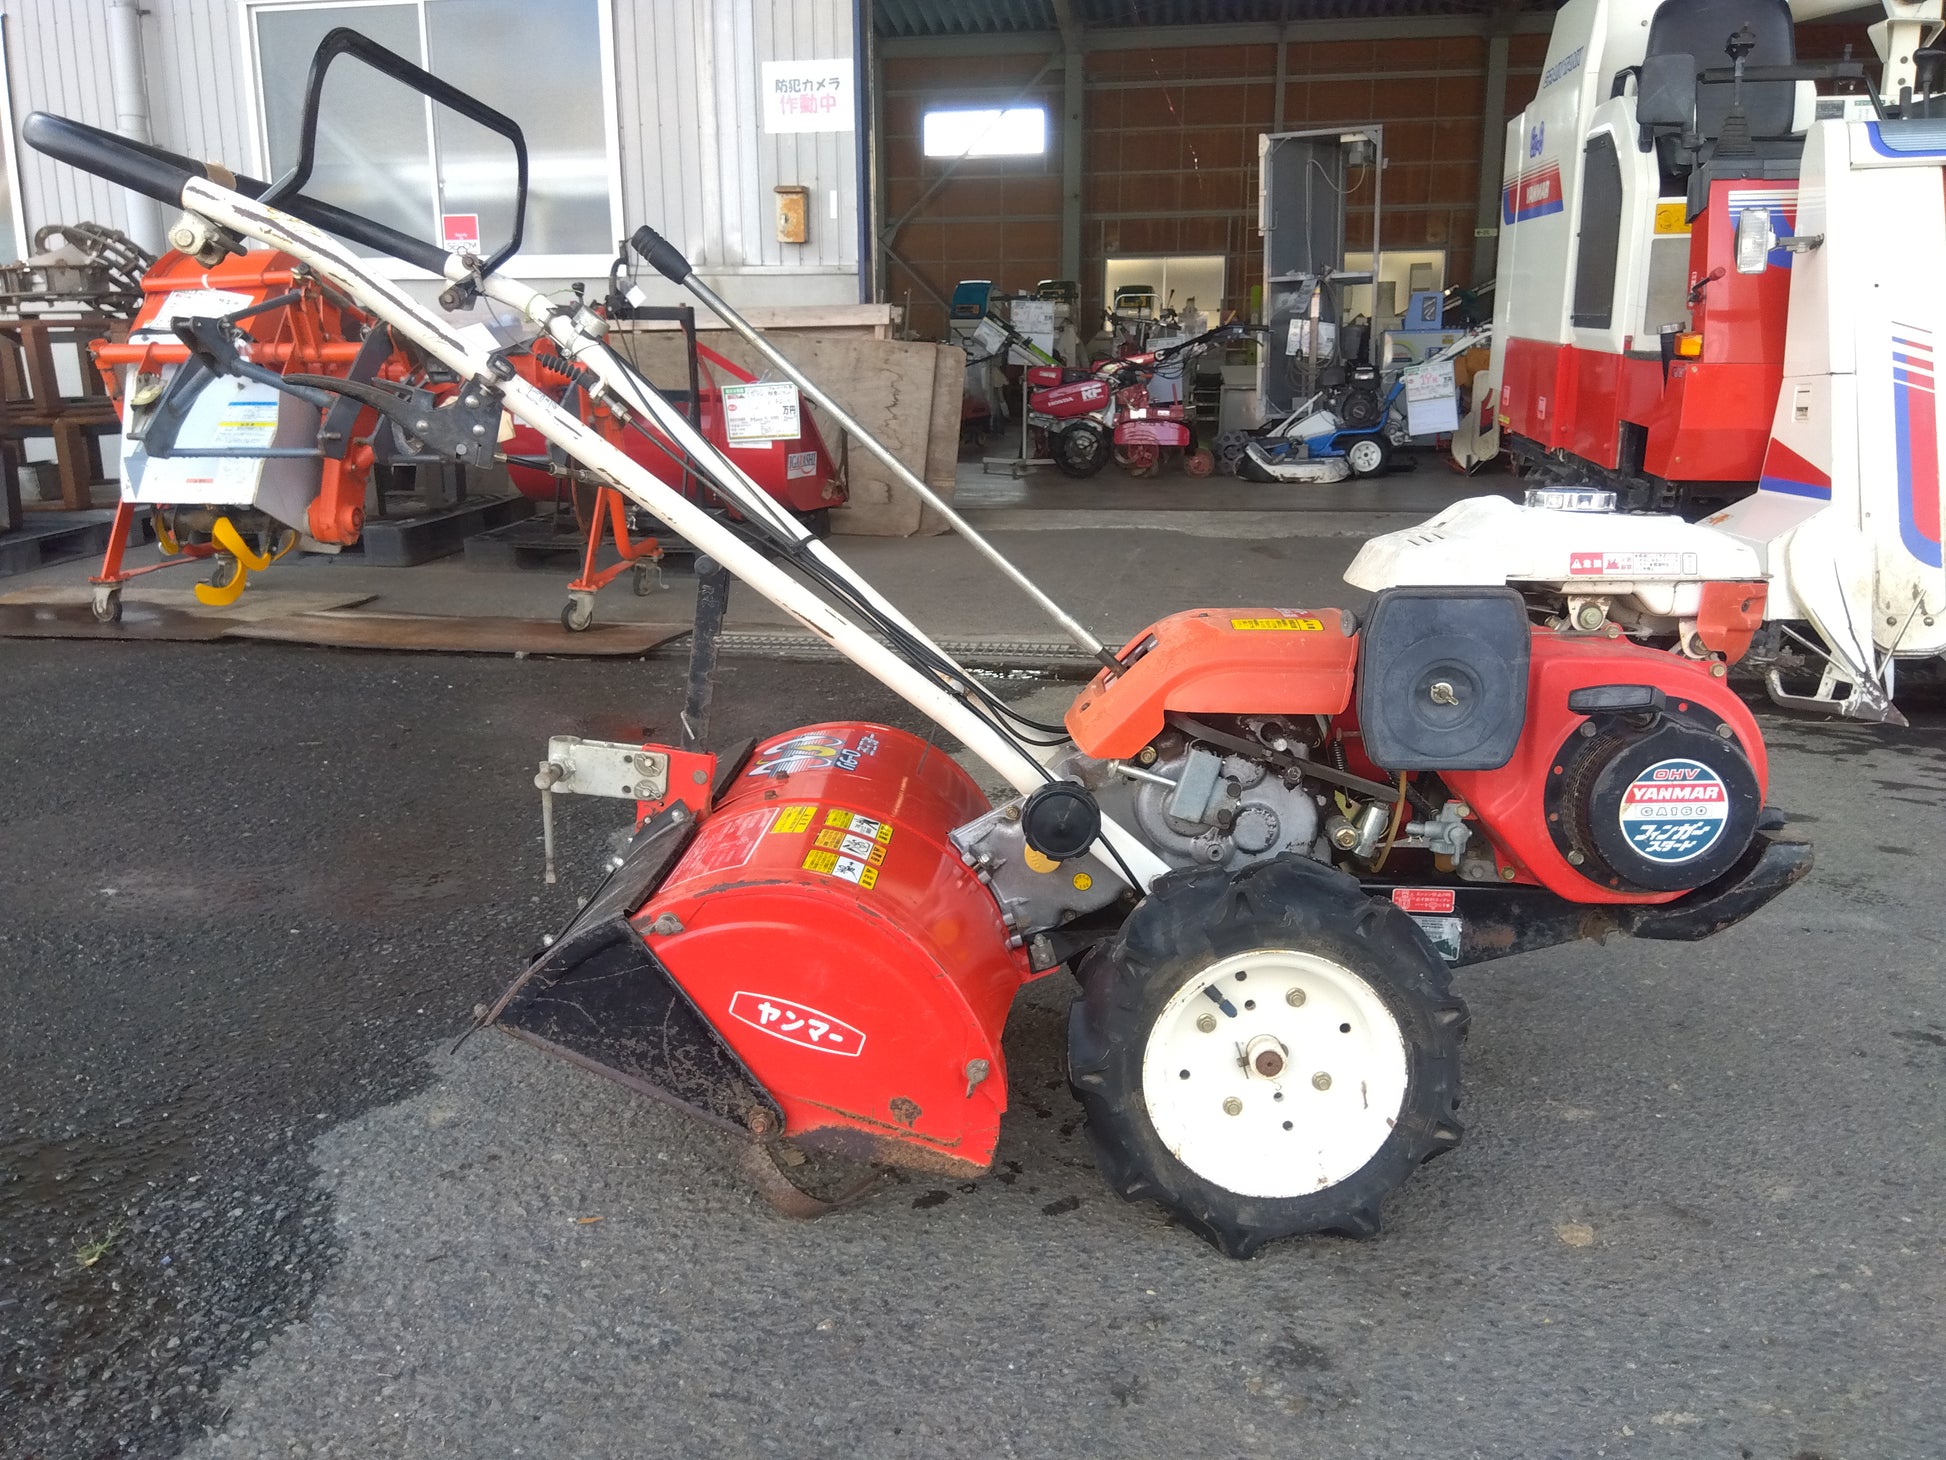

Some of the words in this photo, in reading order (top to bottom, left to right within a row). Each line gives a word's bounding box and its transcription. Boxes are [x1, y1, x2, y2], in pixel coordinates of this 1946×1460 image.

[775, 77, 840, 93] 防犯カメラ
[780, 93, 837, 114] 作動中
[782, 405, 796, 415] 万円
[1653, 768, 1700, 780] OHV
[1632, 786, 1719, 801] YANMAR
[1640, 806, 1707, 817] GA160
[1633, 821, 1711, 840] フィンガー
[758, 1002, 843, 1042] ヤンマー
